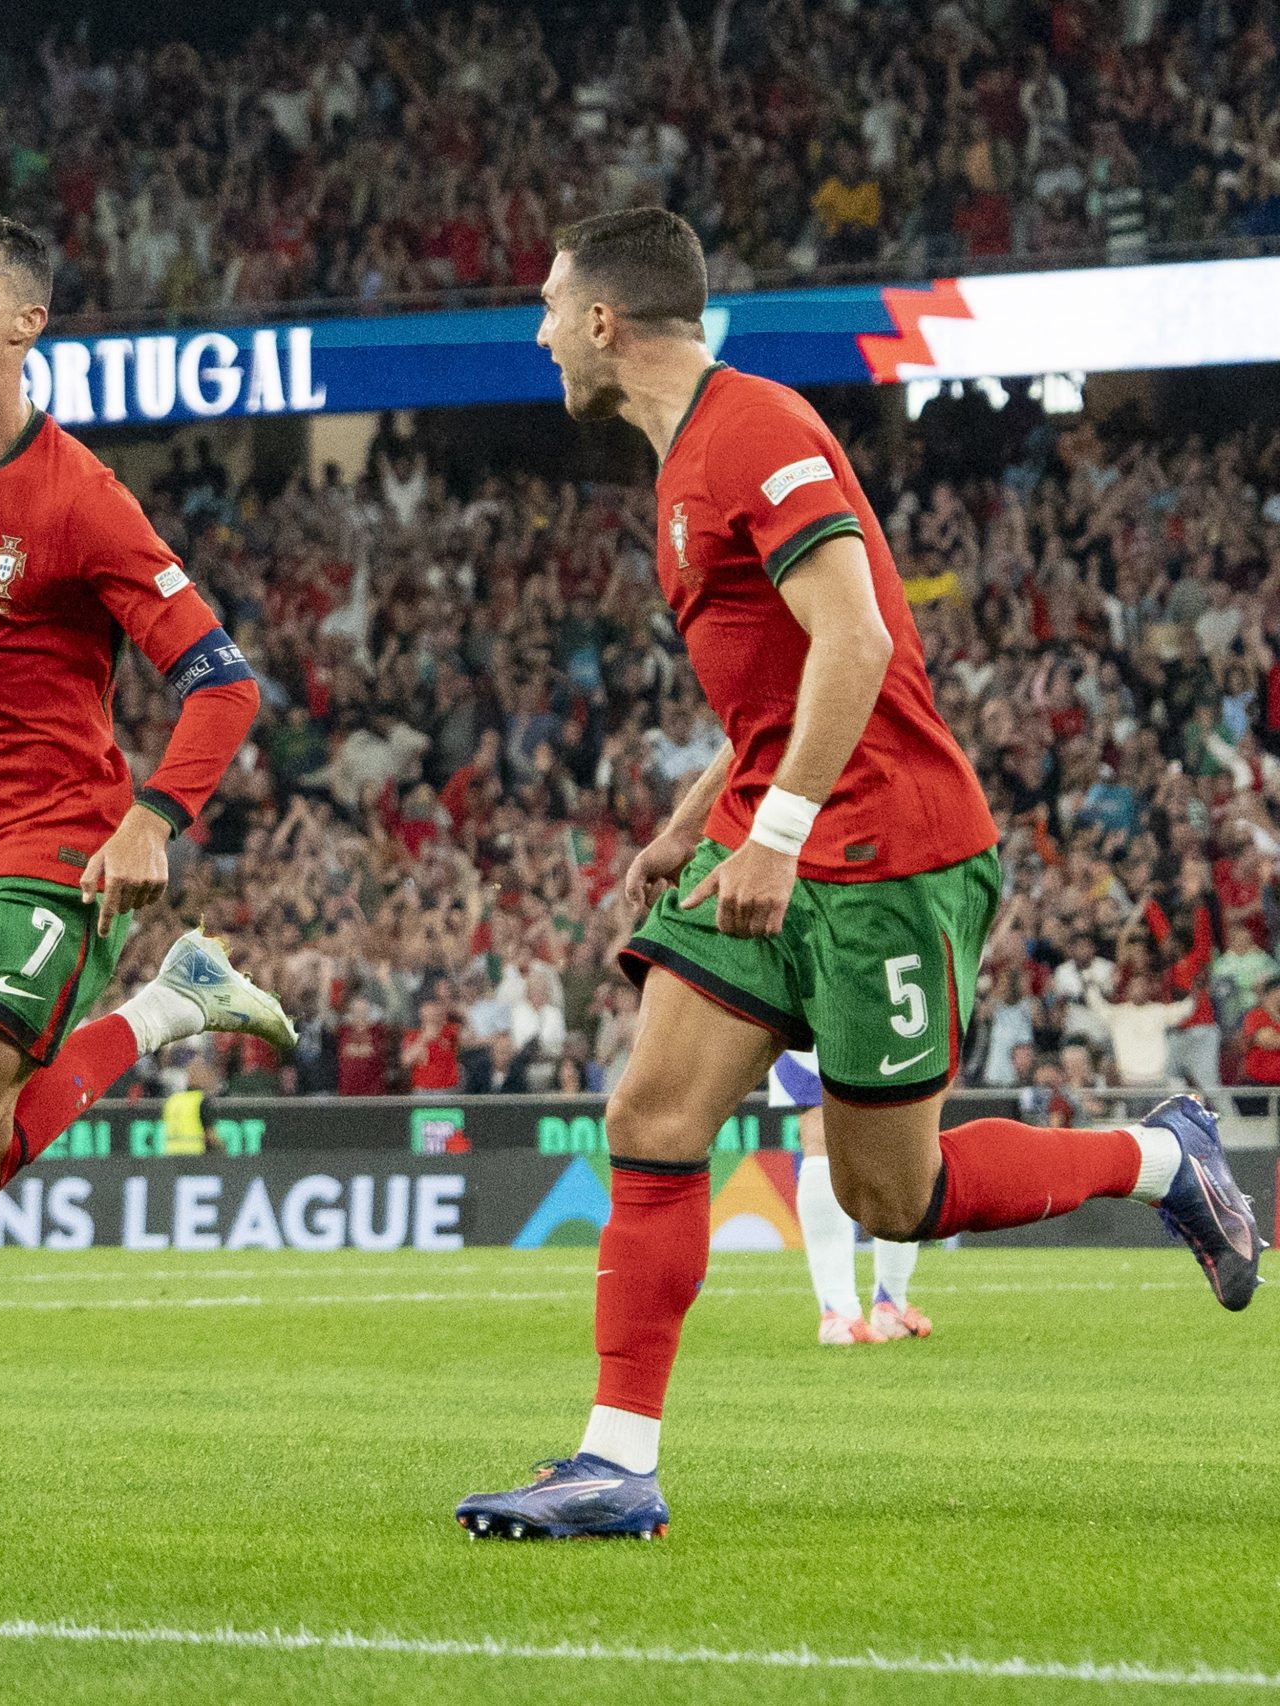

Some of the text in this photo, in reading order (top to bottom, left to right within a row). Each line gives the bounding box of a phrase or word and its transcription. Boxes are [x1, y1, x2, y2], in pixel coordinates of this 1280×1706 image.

[20, 326, 327, 424] ORTUGAL
[175, 657, 211, 691] RESPECT
[20, 906, 66, 981] 7
[884, 953, 929, 1039] 5
[121, 1174, 466, 1250] LEAGUE
